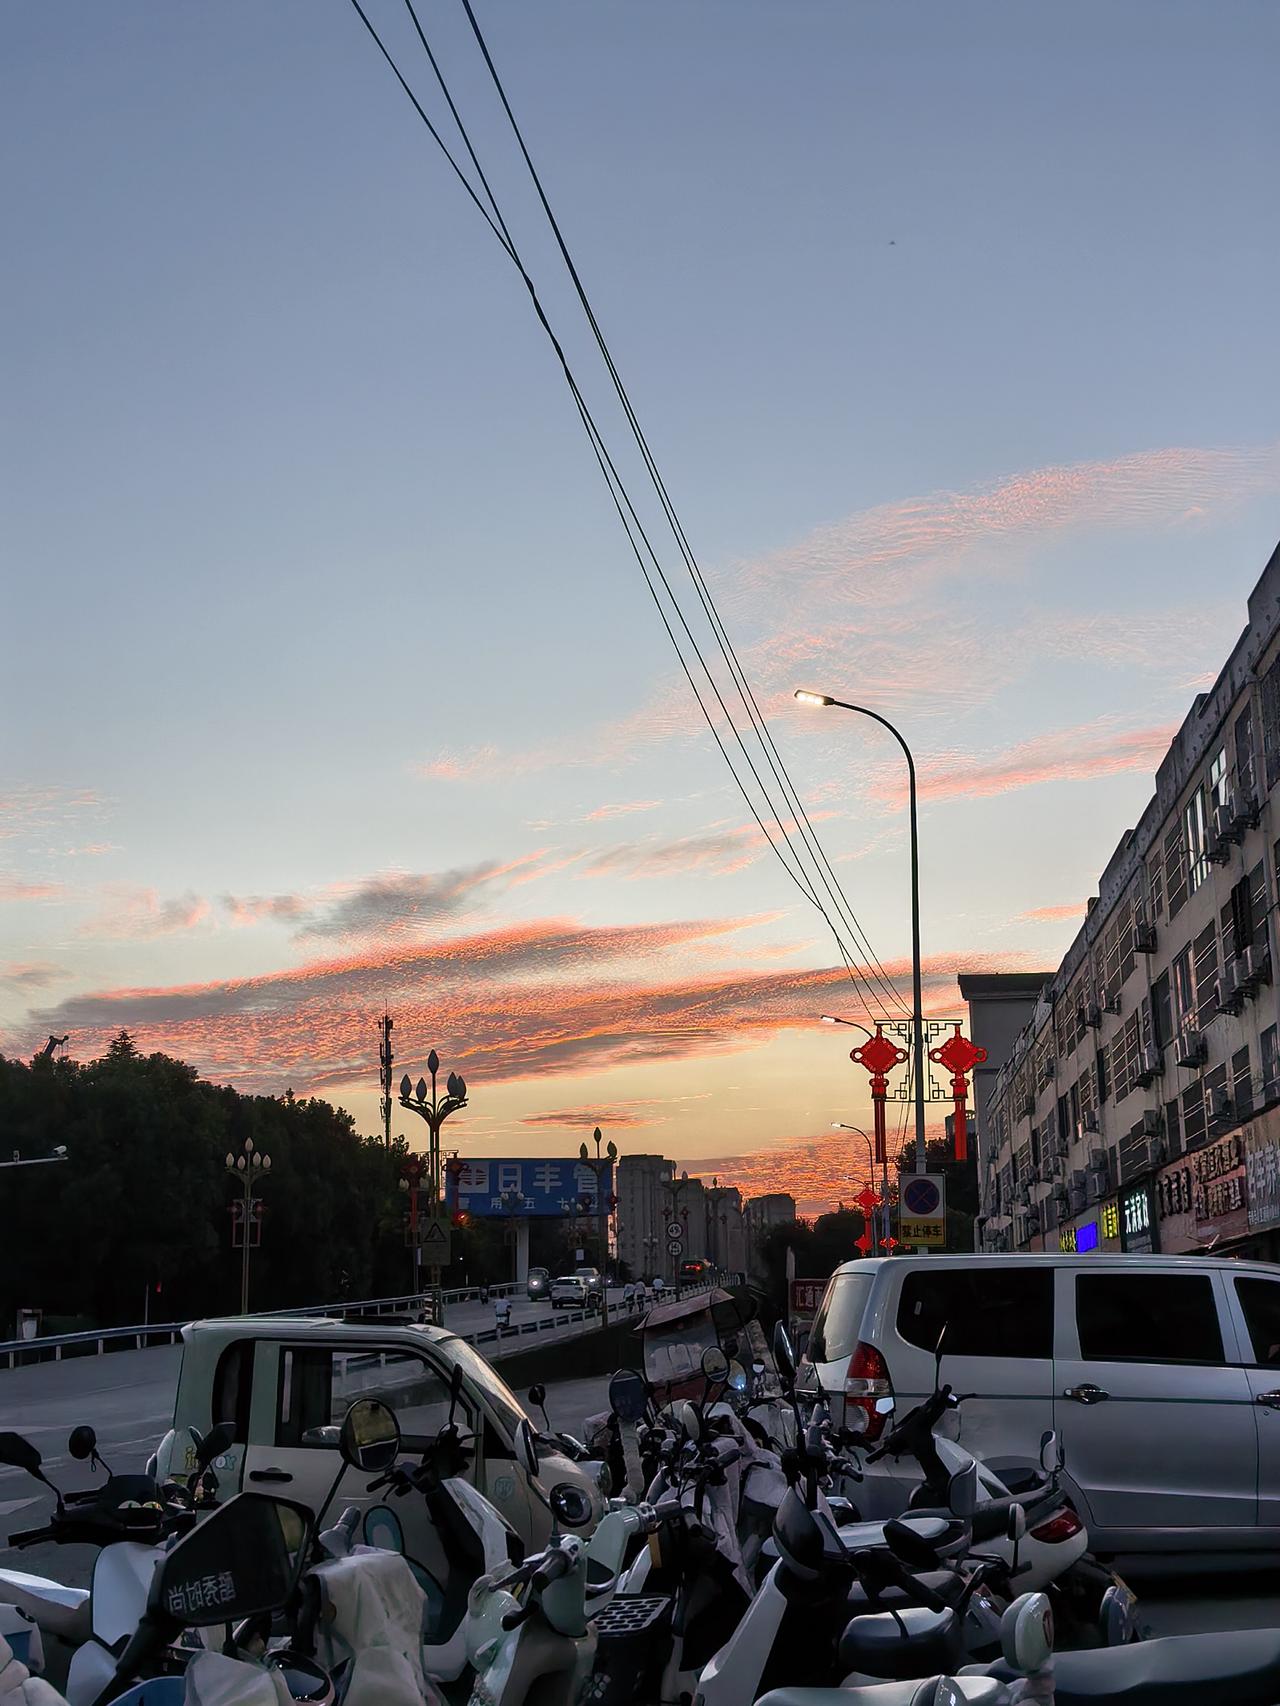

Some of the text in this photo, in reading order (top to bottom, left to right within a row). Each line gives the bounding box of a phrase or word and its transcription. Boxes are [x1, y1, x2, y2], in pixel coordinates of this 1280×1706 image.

[498, 1163, 600, 1194] 日丰管
[902, 1224, 942, 1238] 禁止停车
